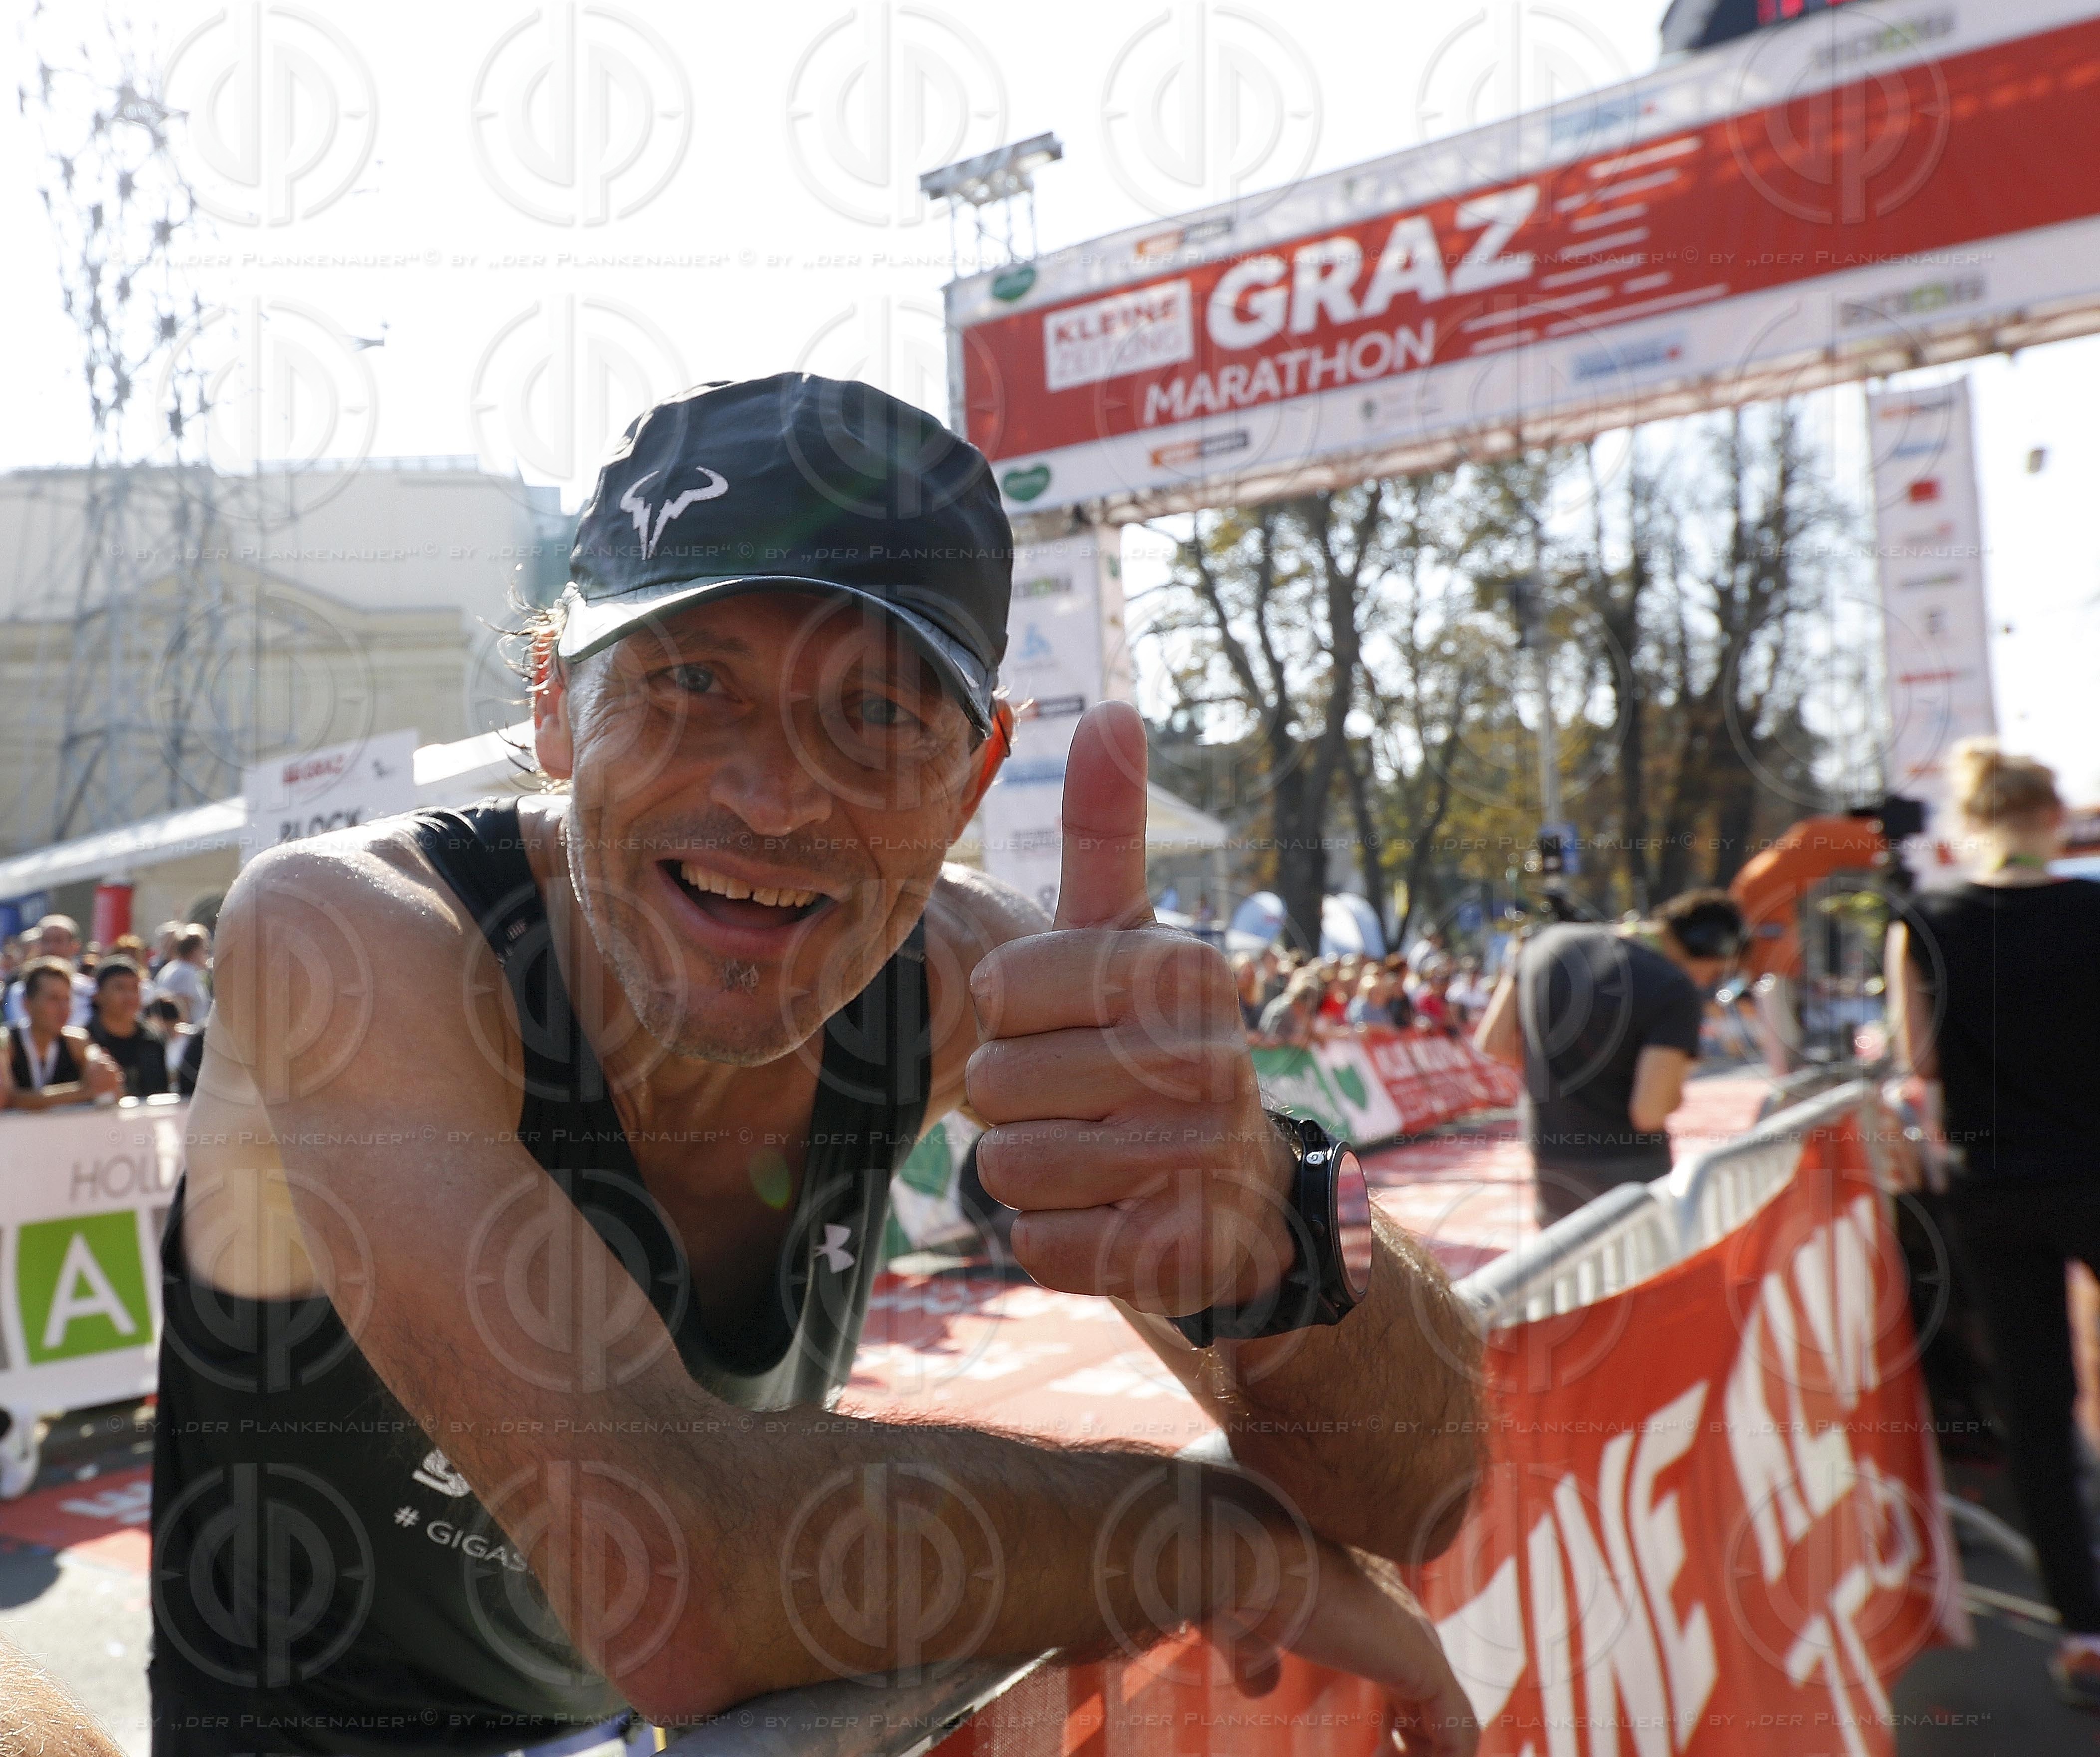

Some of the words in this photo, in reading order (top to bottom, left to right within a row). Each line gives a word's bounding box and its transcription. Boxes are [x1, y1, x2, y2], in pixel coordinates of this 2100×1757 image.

[1205, 183, 1541, 351] GRAZ
[1054, 295, 1179, 345] KLEINE
[1142, 320, 1436, 426] MARATHON
[426, 1520, 534, 1574] GIGAS
